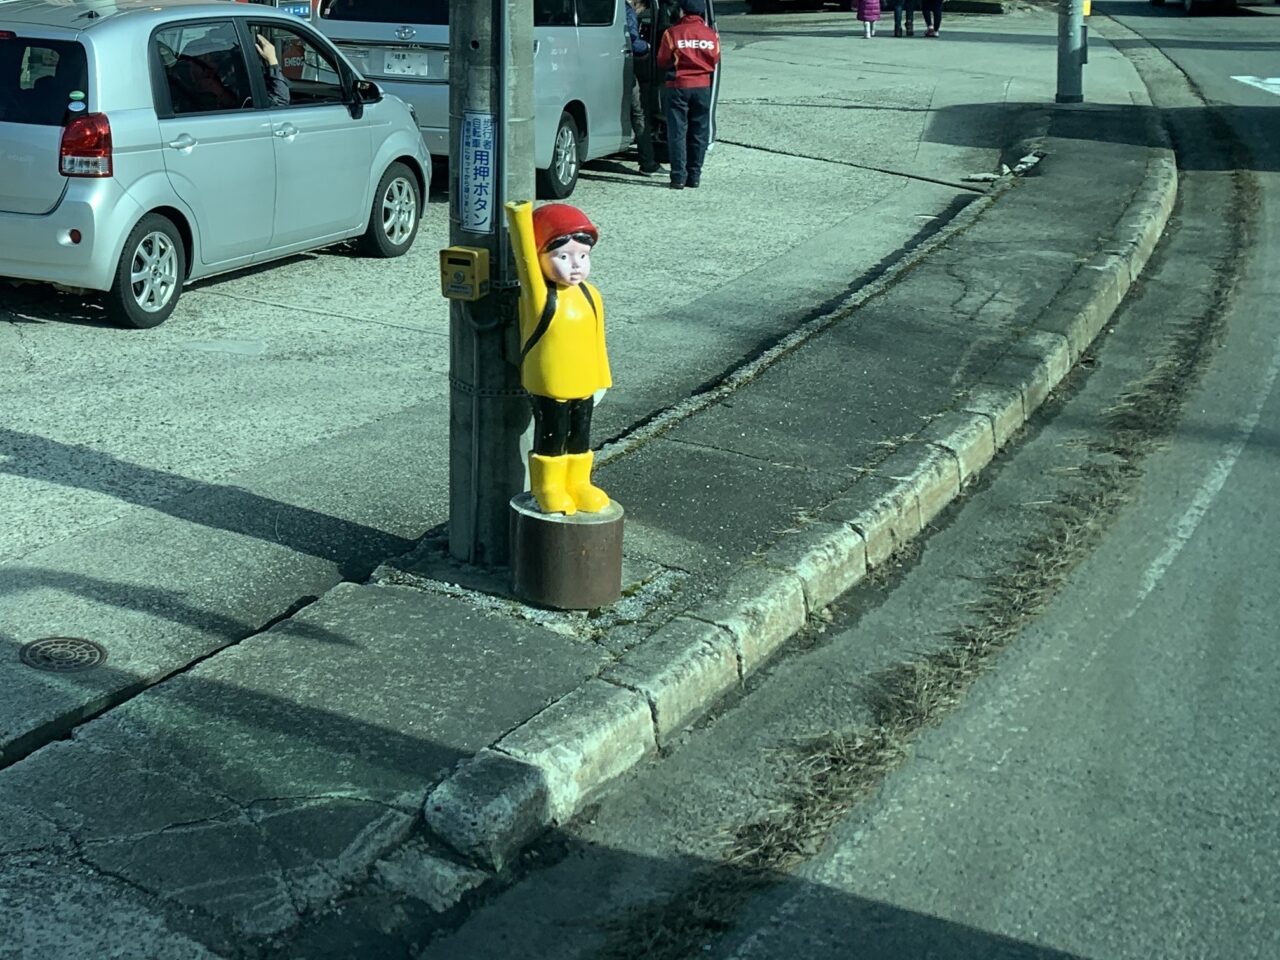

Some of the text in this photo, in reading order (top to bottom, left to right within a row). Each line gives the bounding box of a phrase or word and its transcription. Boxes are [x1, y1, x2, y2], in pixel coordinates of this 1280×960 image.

[677, 39, 715, 50] ENEOS
[473, 150, 490, 226] 用押ボタン
